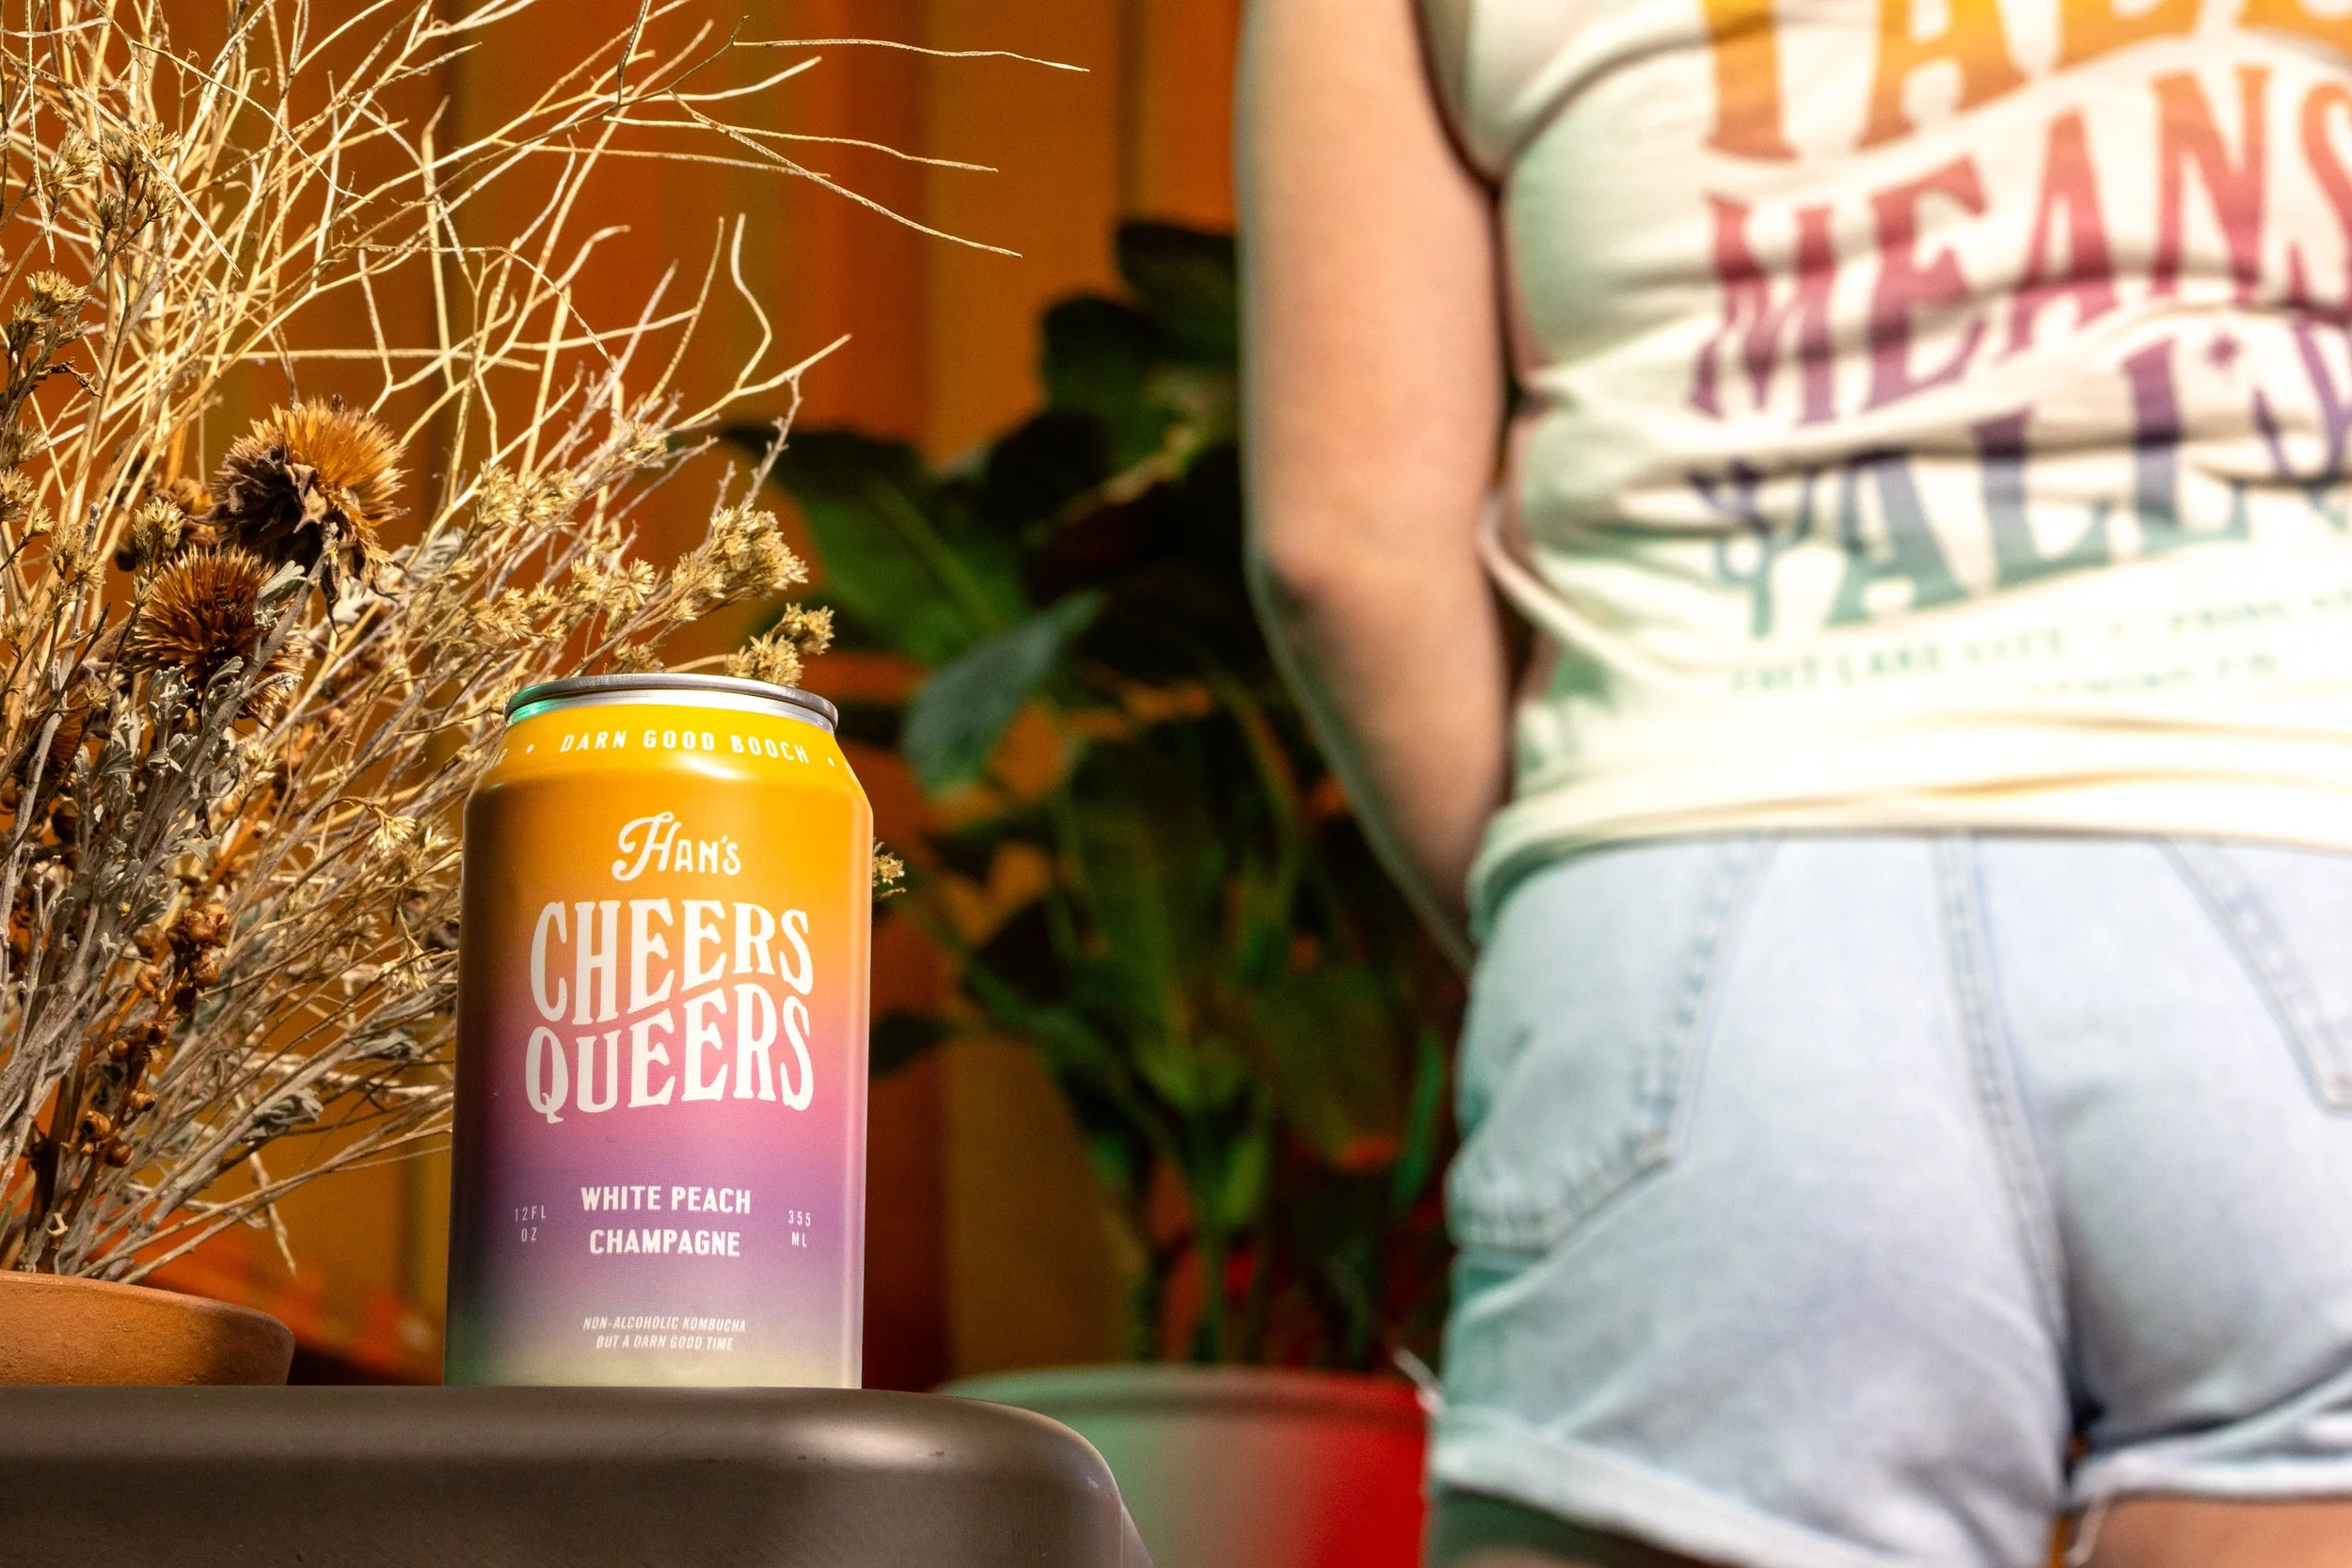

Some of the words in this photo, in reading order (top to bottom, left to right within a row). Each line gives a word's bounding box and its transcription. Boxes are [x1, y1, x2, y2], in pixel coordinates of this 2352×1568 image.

[560, 729, 627, 752] DARN
[643, 729, 715, 751] GOOD
[731, 735, 810, 764] BOOCH
[530, 897, 814, 1026] CHEERS
[524, 983, 814, 1124] QUEERS
[580, 1185, 661, 1211] WHITE
[672, 1187, 751, 1214] PEACH
[788, 1210, 812, 1227] 355
[521, 1227, 538, 1243] OZ
[590, 1228, 740, 1257] CHAMPAGNE
[791, 1231, 807, 1247] ML
[582, 1316, 679, 1331] NON-ALCOHOLIC
[682, 1317, 746, 1333] KOMBUCHA
[596, 1334, 621, 1349] BUT
[621, 1335, 630, 1348] A
[633, 1335, 667, 1349] DARN
[669, 1335, 703, 1351] GOOD
[707, 1337, 735, 1352] TIME
